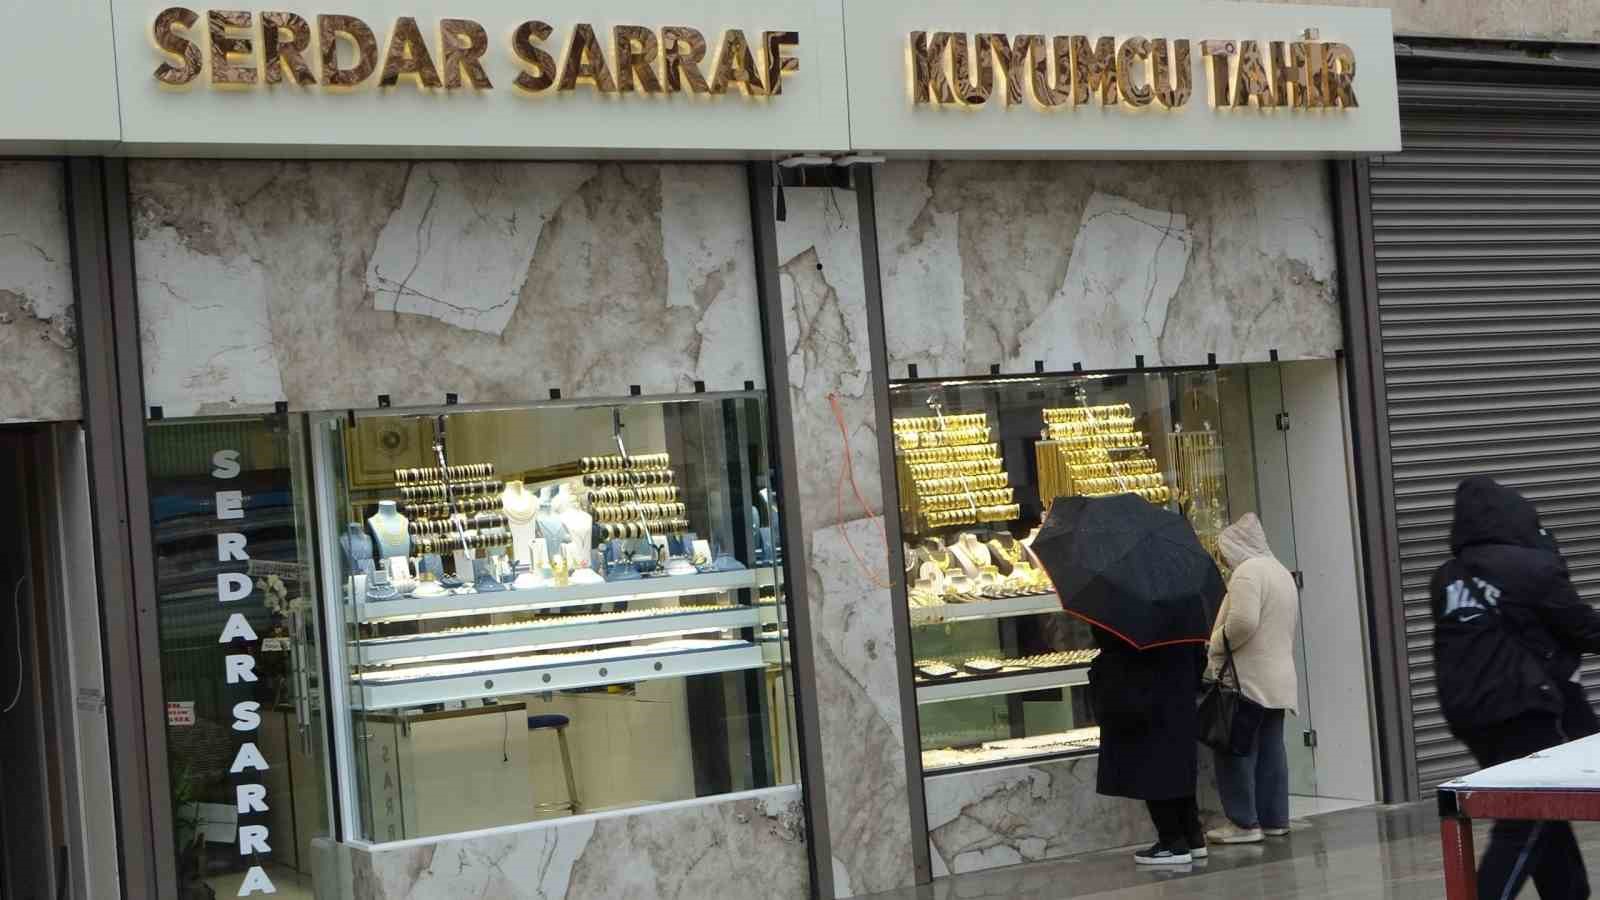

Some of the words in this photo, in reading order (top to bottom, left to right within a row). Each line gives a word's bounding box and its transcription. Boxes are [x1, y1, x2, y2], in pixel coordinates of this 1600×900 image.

[152, 6, 493, 92] SERDAR
[511, 20, 799, 96] SARRAF
[909, 31, 1193, 108] KUYUMCU
[1200, 28, 1359, 109] TAHİR
[211, 449, 258, 684] SERDAR
